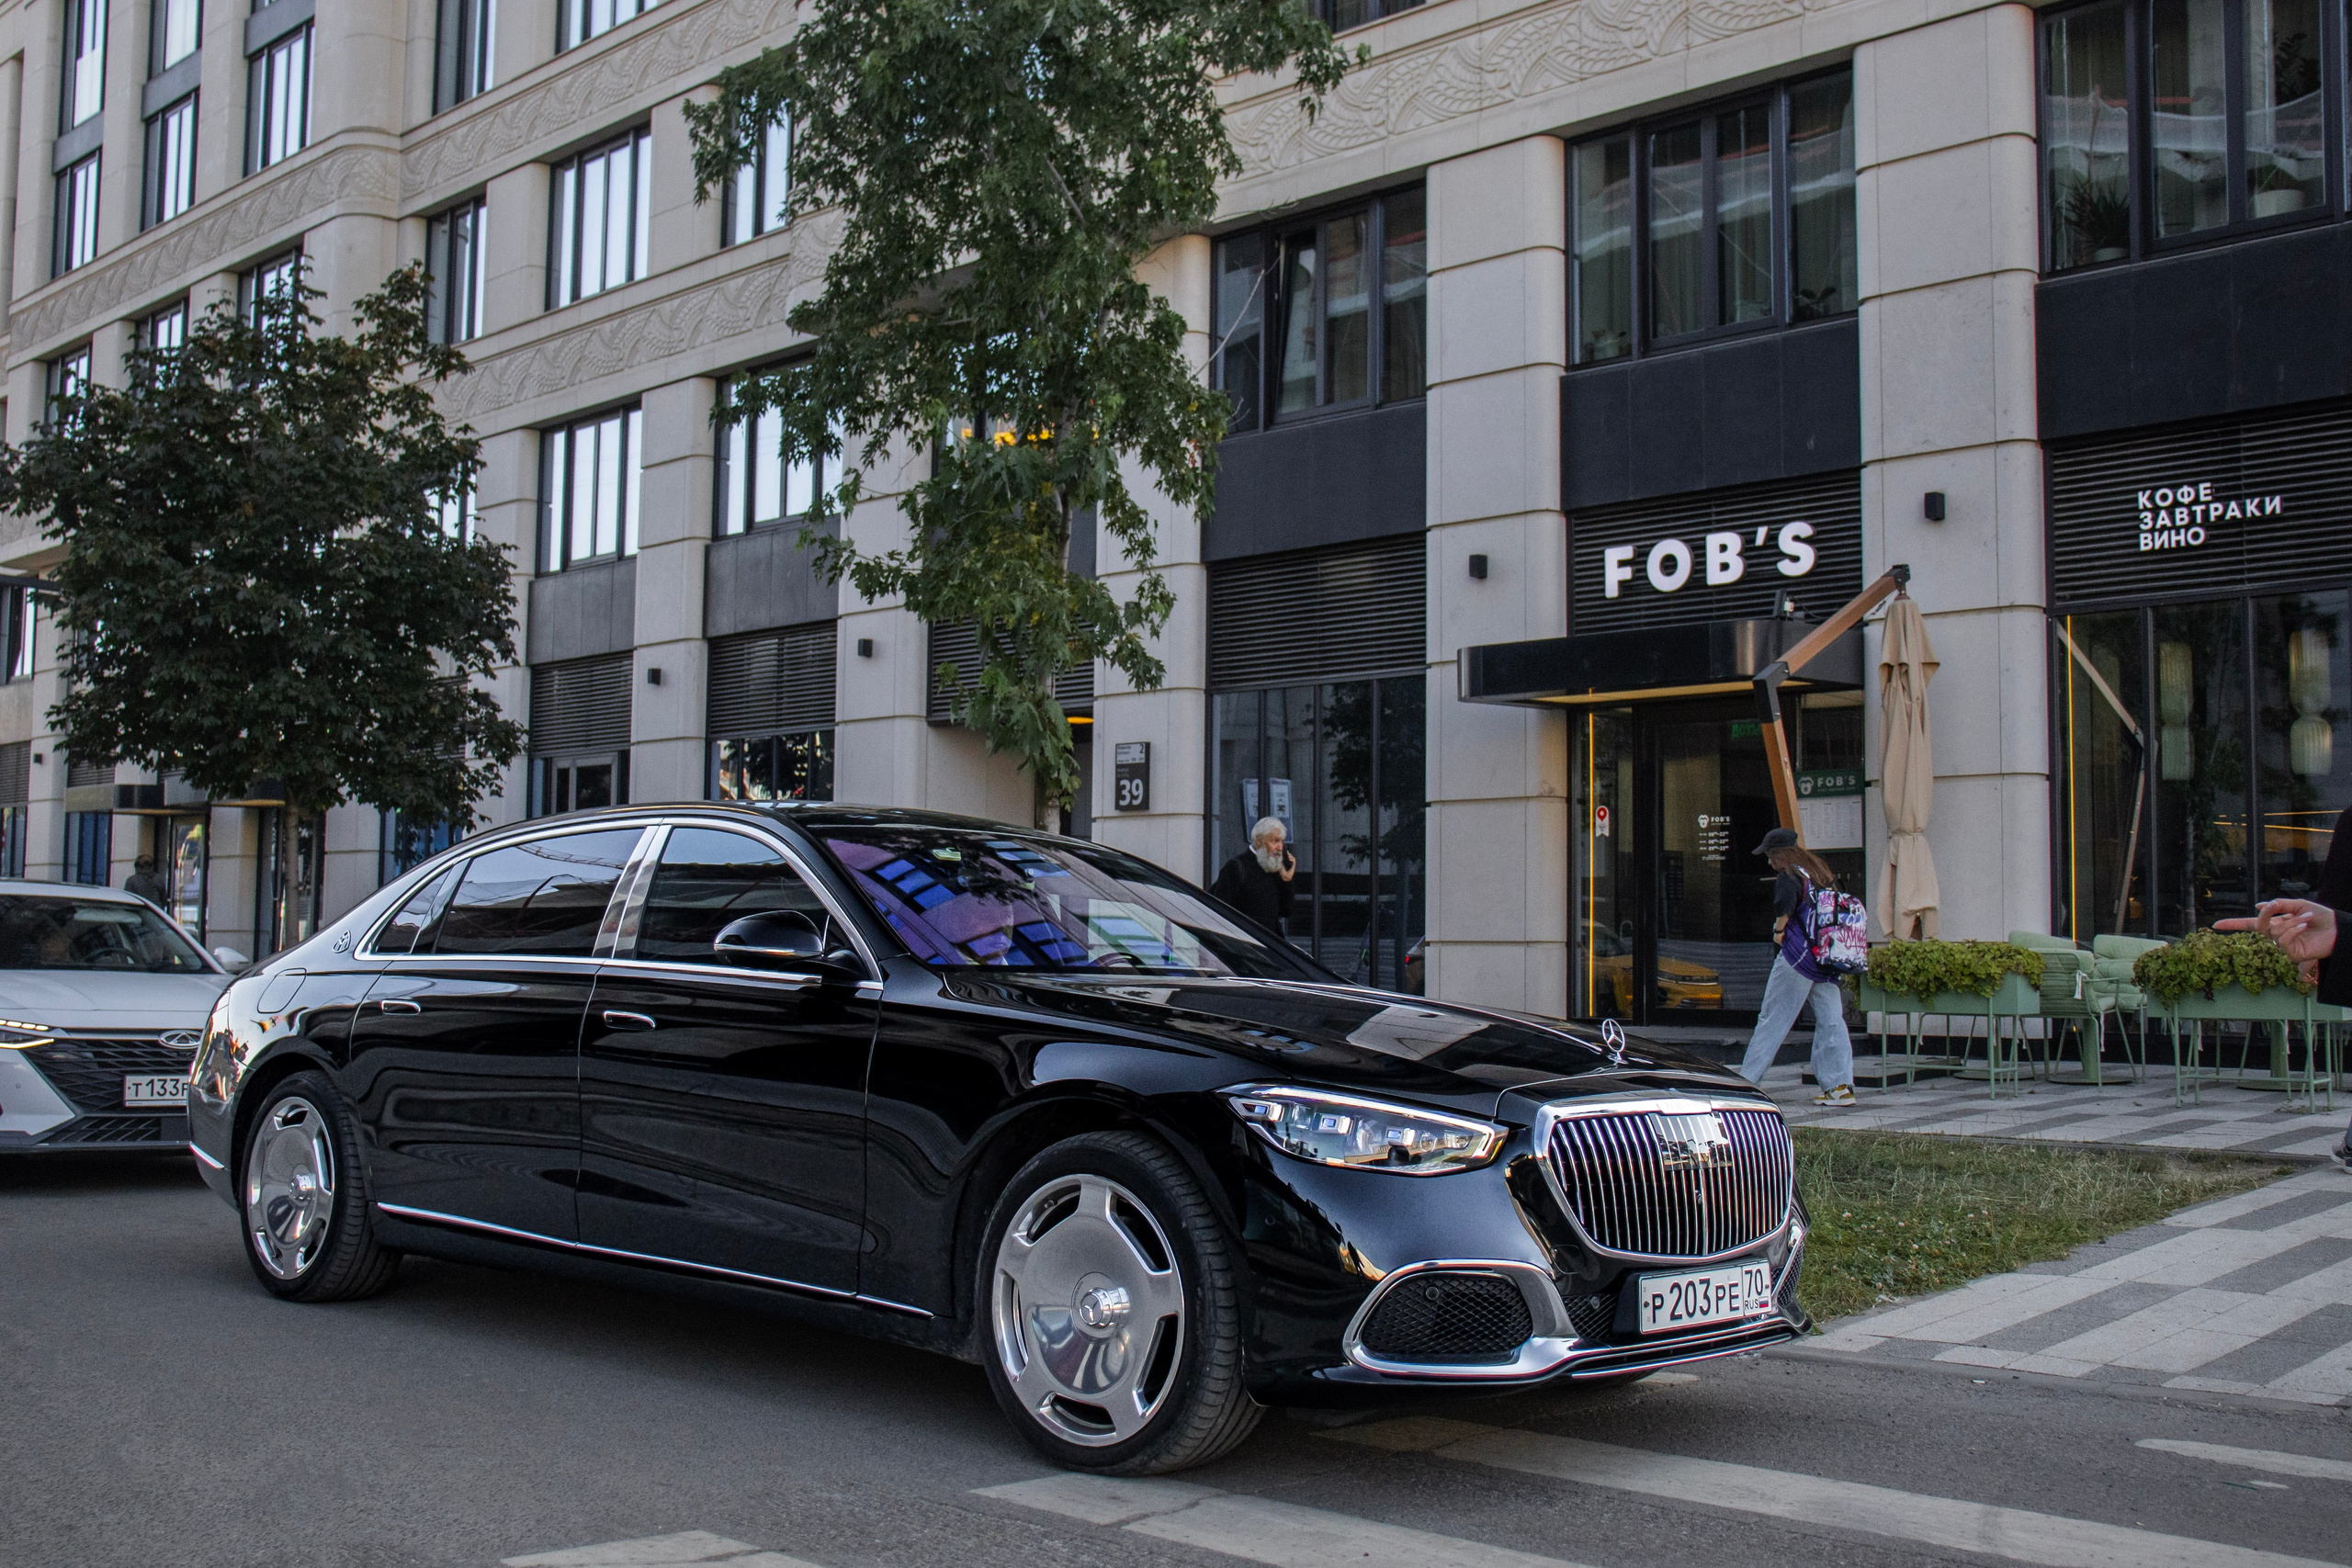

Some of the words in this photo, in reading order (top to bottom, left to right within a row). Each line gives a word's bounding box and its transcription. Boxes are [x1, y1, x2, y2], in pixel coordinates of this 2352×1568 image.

[2137, 482, 2212, 509] КОФЕ
[2139, 495, 2281, 530] ЗАВТРАКИ
[2139, 526, 2205, 551] ВИНО
[1604, 521, 1816, 599] FOB'S
[1119, 778, 1144, 806] 39
[1817, 775, 1856, 787] FOB'S
[1744, 1268, 1763, 1298] 70
[1745, 1299, 1758, 1311] RUS
